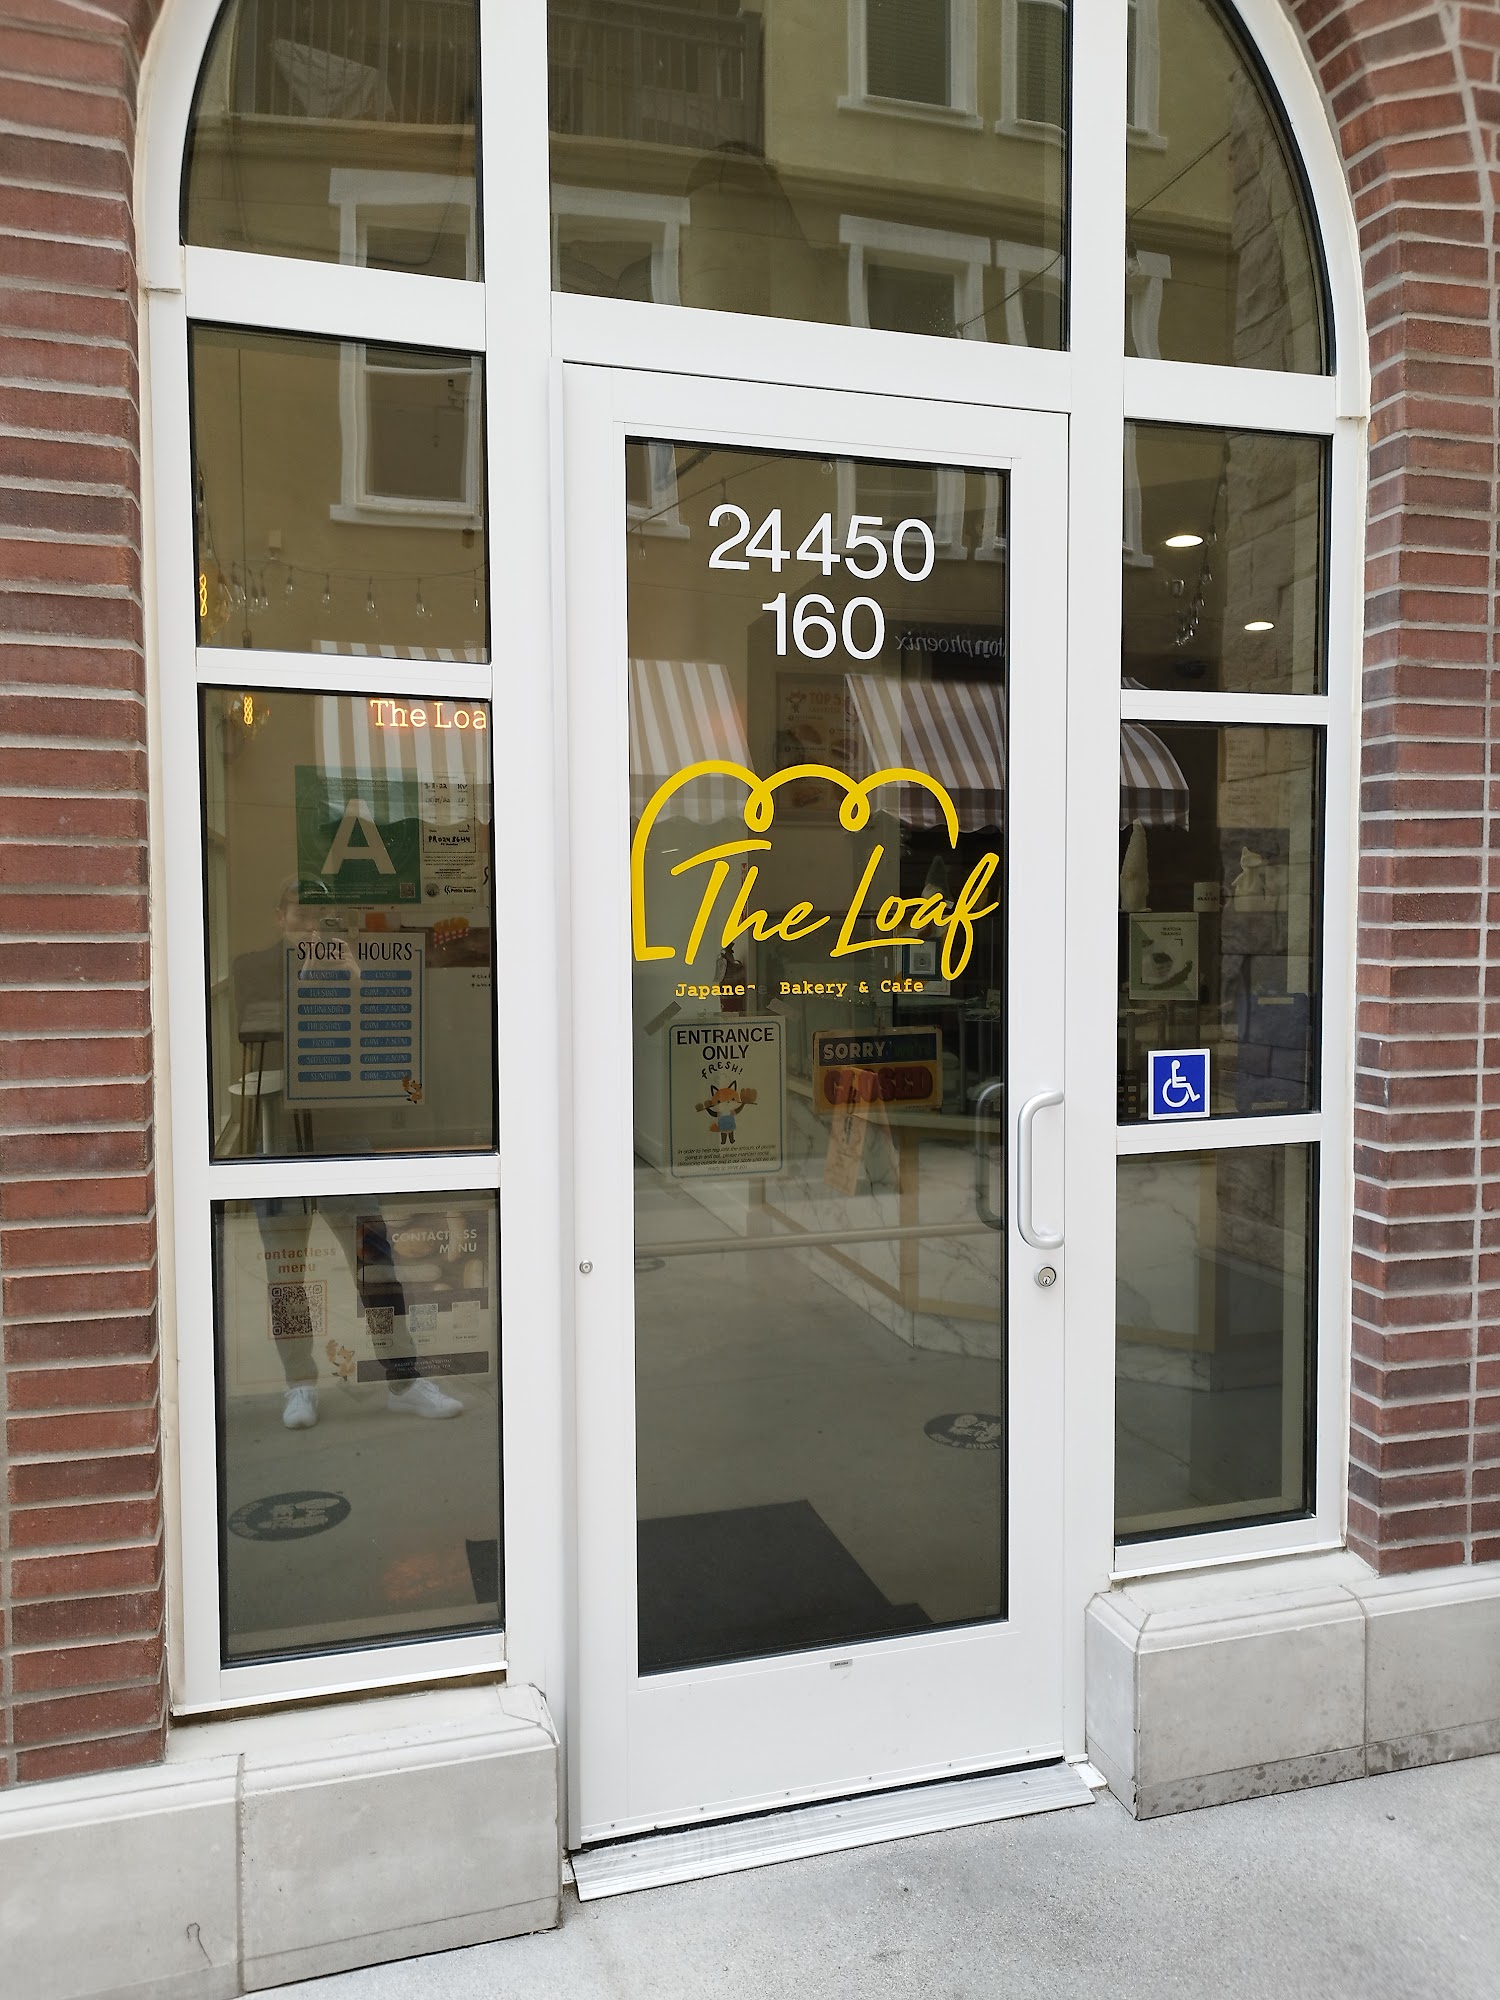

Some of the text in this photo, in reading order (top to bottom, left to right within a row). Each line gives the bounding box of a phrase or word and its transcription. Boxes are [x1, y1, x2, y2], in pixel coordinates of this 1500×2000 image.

[708, 503, 935, 582] 24450
[762, 592, 885, 660] 160
[370, 699, 488, 729] The Loa
[321, 798, 397, 875] A
[671, 839, 1000, 981] The Loaf
[297, 941, 413, 961] STORE HOURS
[675, 976, 925, 1000] Japanee Bakery & Cafe
[676, 1027, 775, 1046] ENTRANCE
[702, 1044, 750, 1061] ONLY
[823, 1041, 887, 1061] SORRY
[391, 1228, 478, 1243] CONTACTESS
[256, 1247, 338, 1260] contactless
[439, 1242, 478, 1254] MNU
[278, 1262, 316, 1274] menu
